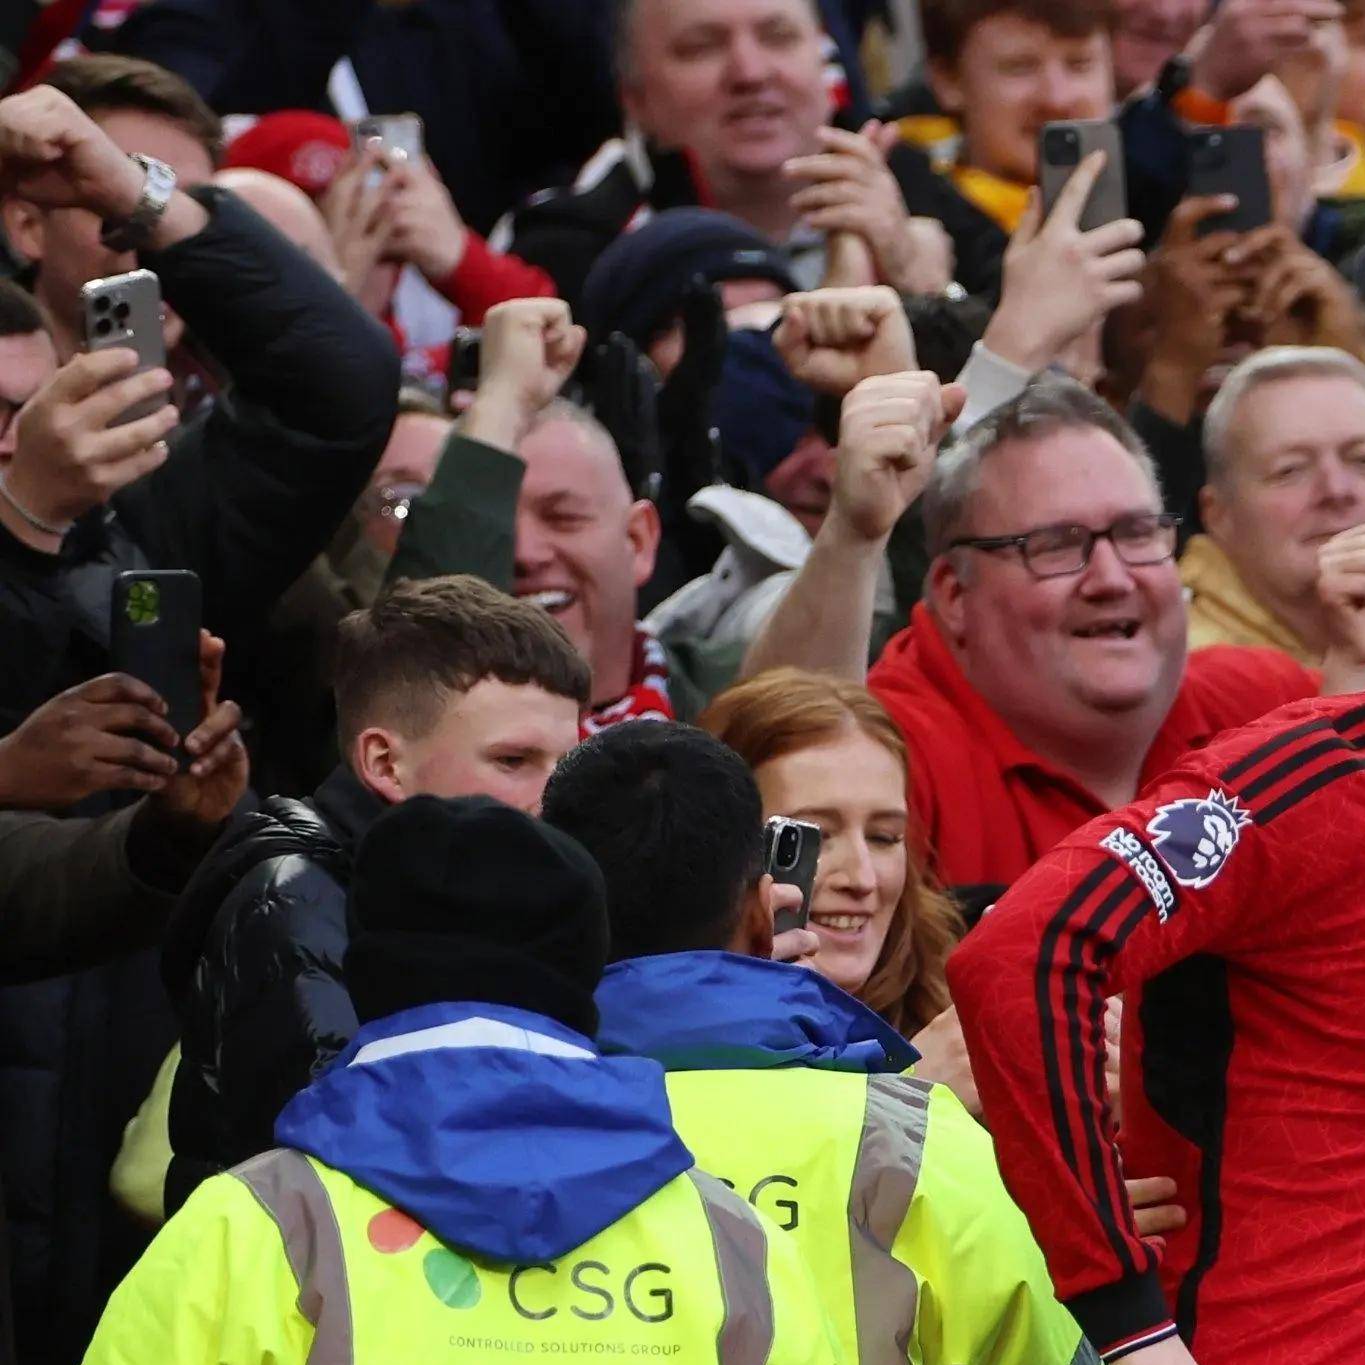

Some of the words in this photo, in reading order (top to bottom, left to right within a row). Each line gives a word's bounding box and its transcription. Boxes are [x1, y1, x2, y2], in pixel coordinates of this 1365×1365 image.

[1138, 850, 1175, 908] room
[508, 1259, 674, 1324] CSG
[448, 1335, 535, 1355] CONTROLLED
[540, 1341, 626, 1355] SOLUTIONS
[631, 1343, 682, 1356] GROUP
